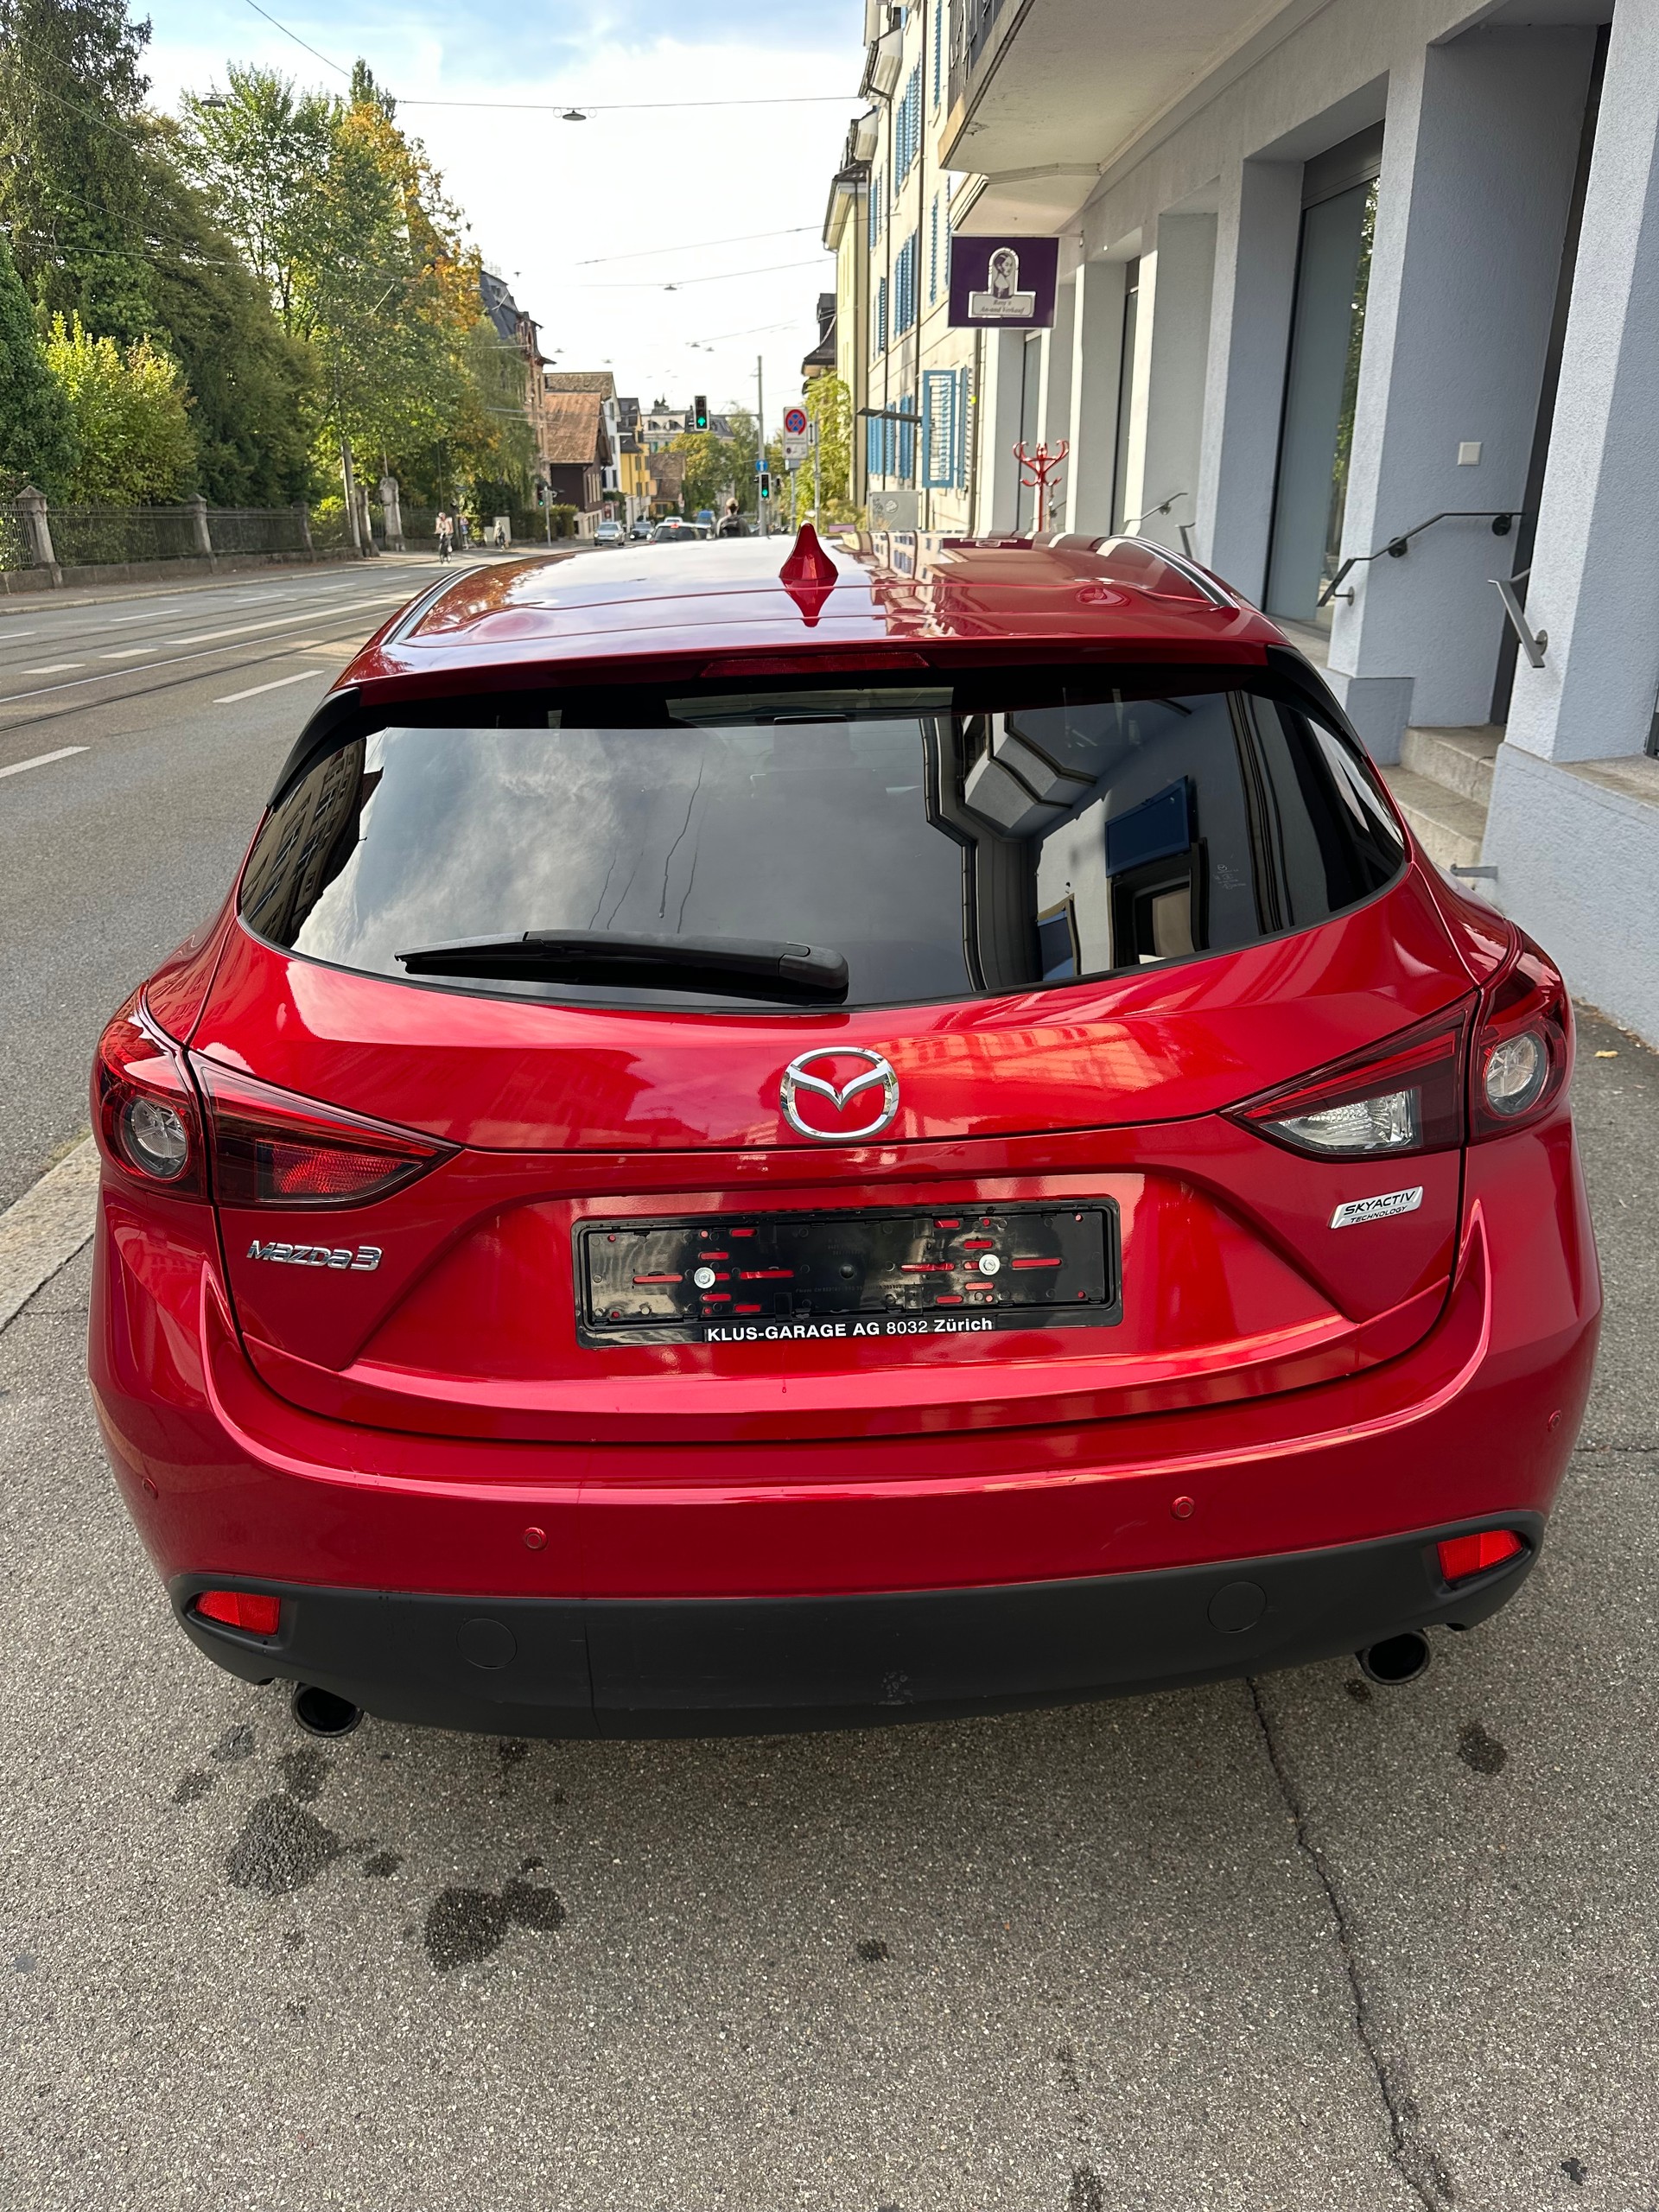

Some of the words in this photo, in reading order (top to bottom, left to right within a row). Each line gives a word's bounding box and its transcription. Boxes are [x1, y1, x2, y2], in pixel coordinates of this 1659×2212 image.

[1344, 1191, 1415, 1216] SKYACTIV
[1351, 1205, 1408, 1223] TECHNOLOGY
[708, 1323, 846, 1341] KLUS-GARAGE
[852, 1322, 880, 1336] AG
[887, 1320, 928, 1335] 8032
[933, 1317, 993, 1333] Zürich
